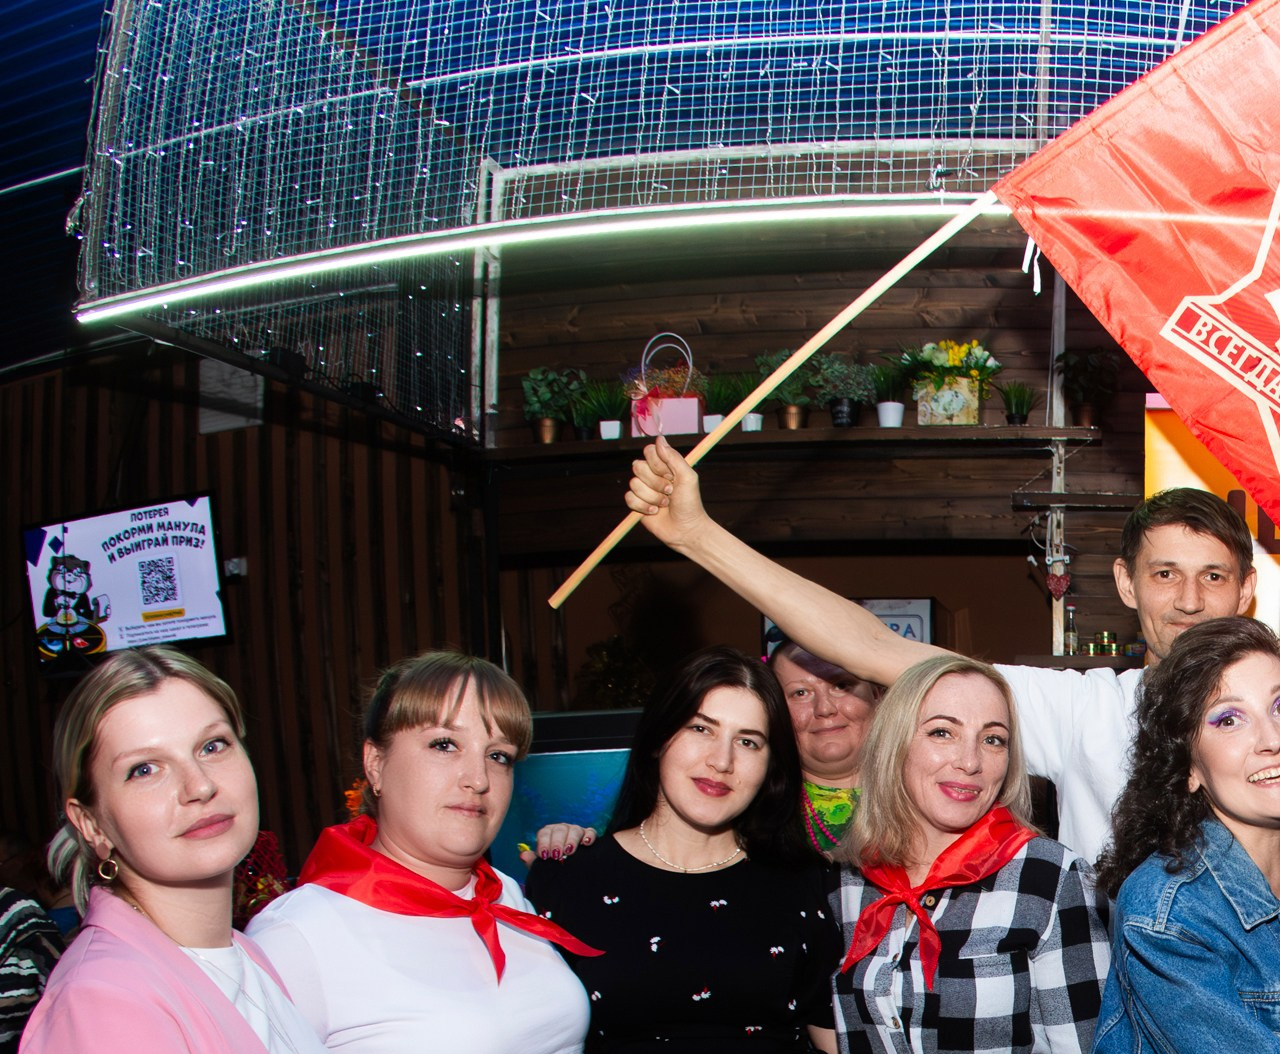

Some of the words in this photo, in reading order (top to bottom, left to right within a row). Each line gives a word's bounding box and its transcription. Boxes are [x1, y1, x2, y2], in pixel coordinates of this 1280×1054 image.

[130, 507, 169, 522] ЛОТЕРЕЯ
[101, 523, 154, 552] ПОКОРМИ
[156, 521, 206, 536] МАНУЛА
[107, 552, 117, 564] И
[116, 533, 169, 558] ВЫИГРАЙ
[171, 535, 205, 549] ПРИЗ!
